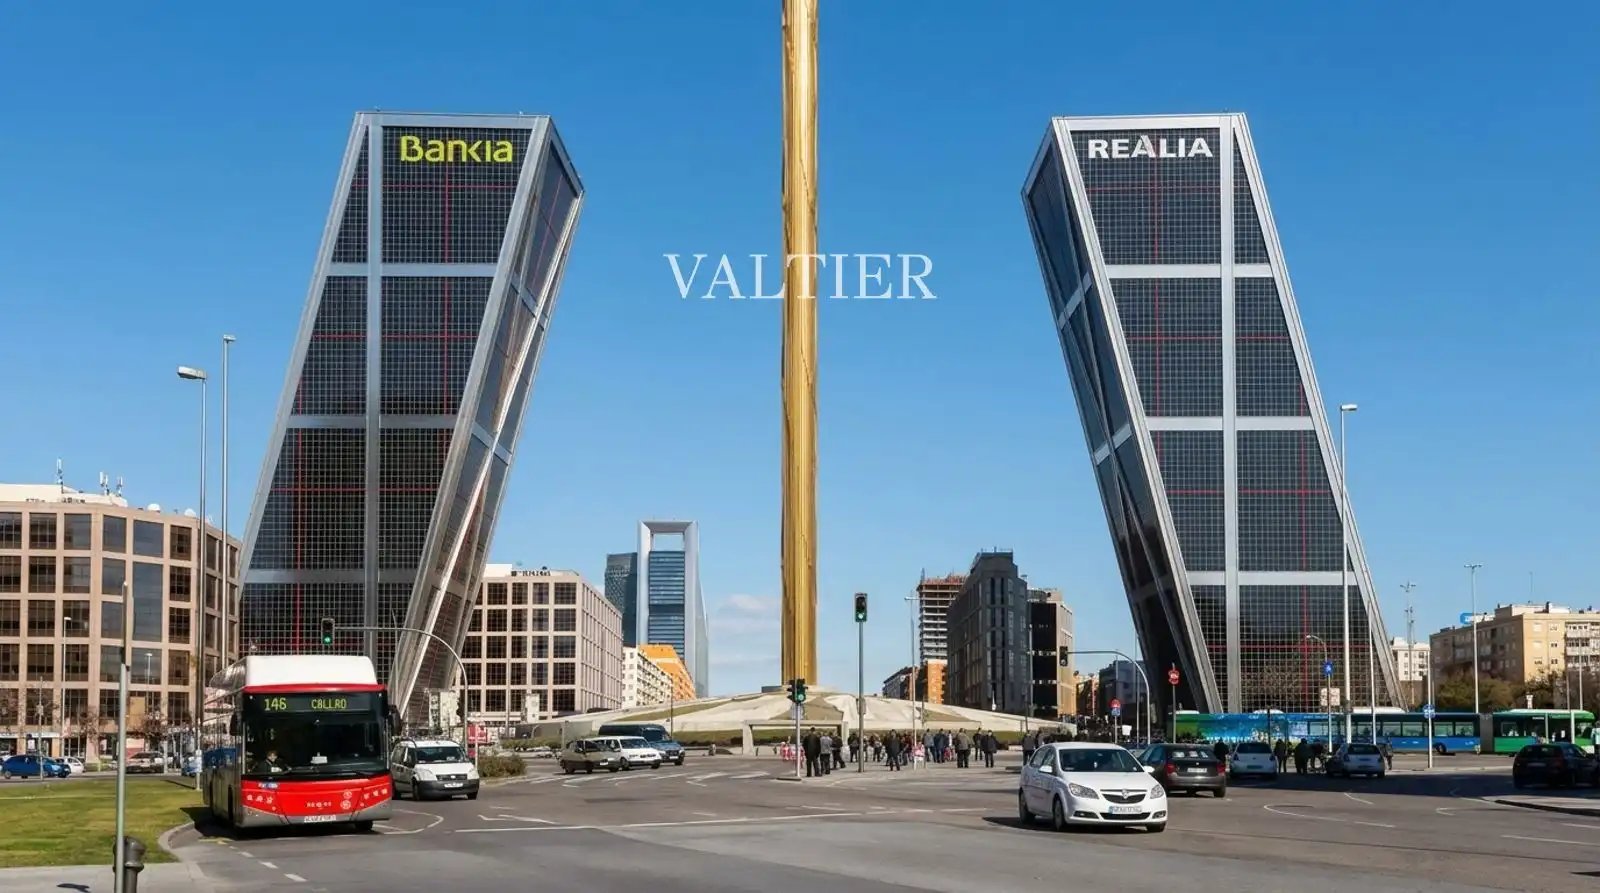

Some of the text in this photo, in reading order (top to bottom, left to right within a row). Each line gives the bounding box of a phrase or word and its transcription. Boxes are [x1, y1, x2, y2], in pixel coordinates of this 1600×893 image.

[400, 136, 513, 162] Bankia
[1088, 135, 1213, 158] REALIA
[264, 698, 287, 711] 146
